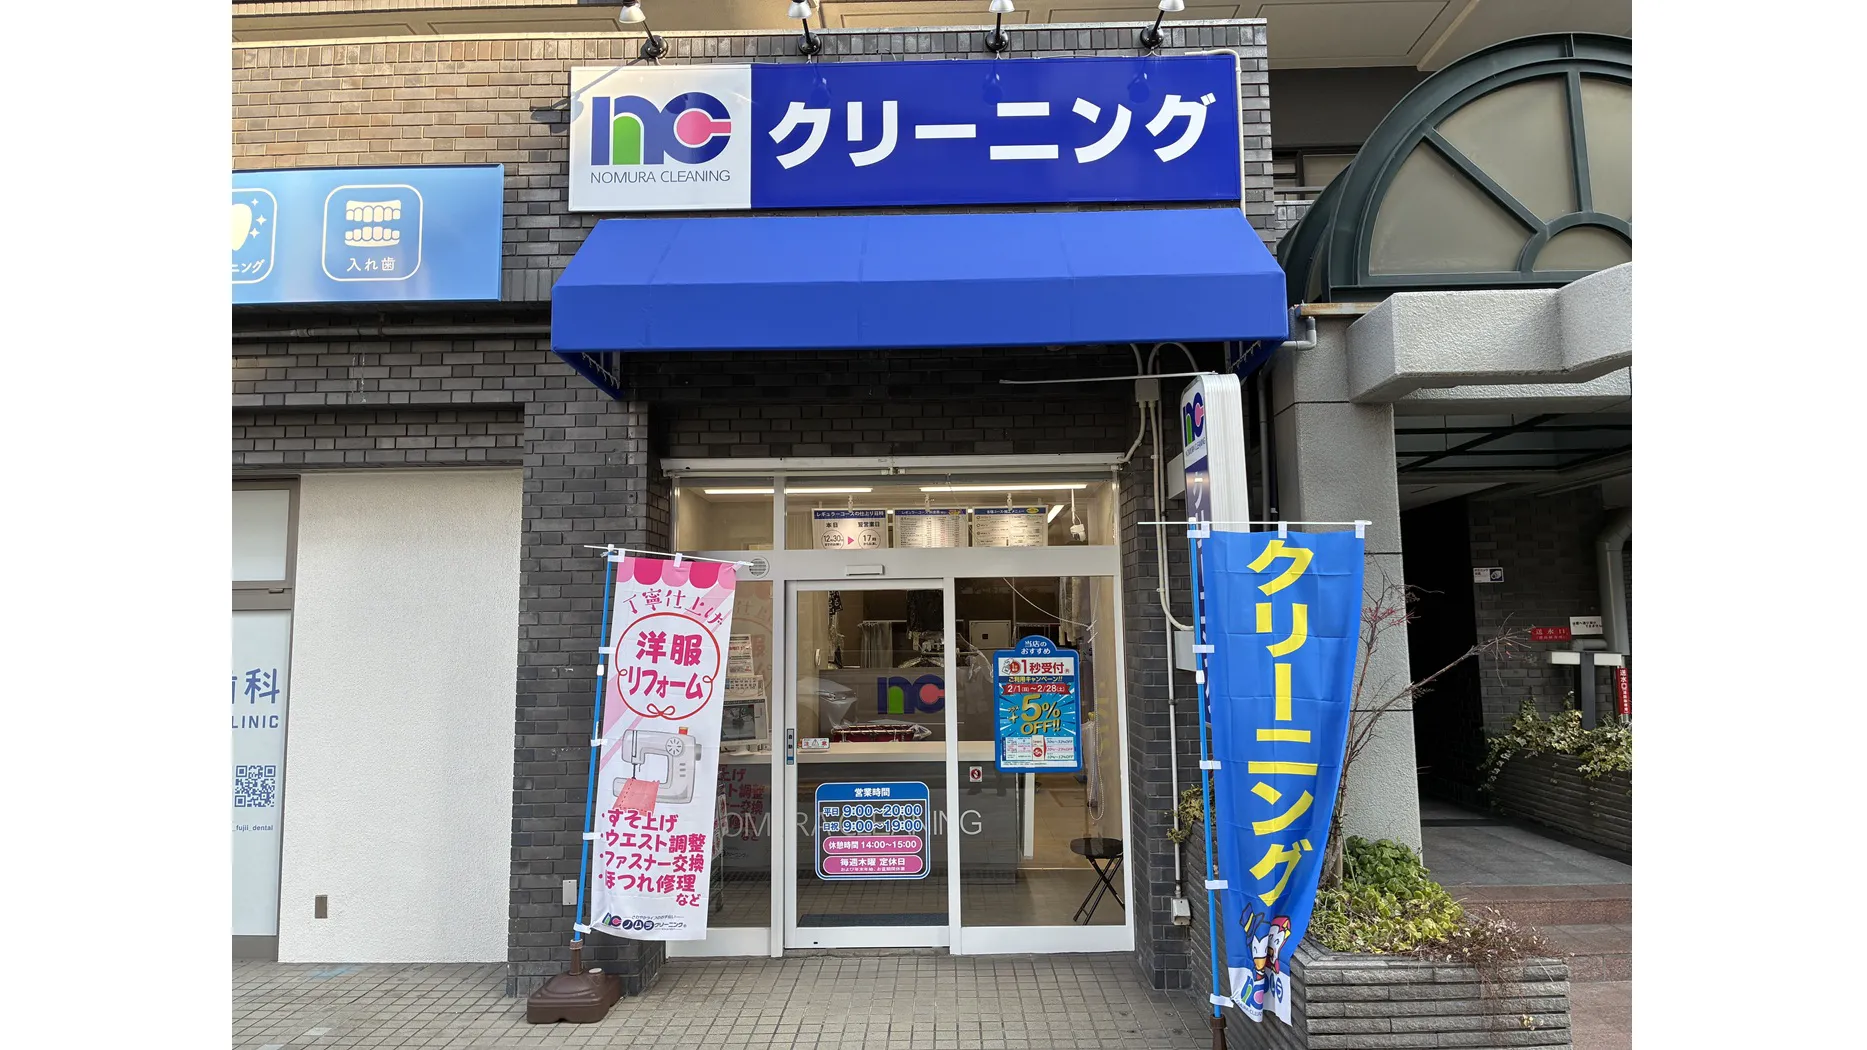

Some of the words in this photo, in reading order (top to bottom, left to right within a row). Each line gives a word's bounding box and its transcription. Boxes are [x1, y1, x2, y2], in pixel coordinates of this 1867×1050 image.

[769, 92, 1216, 169] クリーニング
[590, 171, 656, 184] NOMURA
[660, 169, 731, 183] CLEANING
[346, 256, 396, 272] 入れ歯
[623, 588, 723, 626] 丁寧仕上げ
[635, 630, 703, 667] 洋服
[1021, 659, 1065, 674] 1秒受付
[232, 668, 280, 704] 科
[628, 665, 704, 700] リフォーム
[1020, 719, 1061, 735] OFF!!
[1246, 540, 1318, 907] クリーニング
[854, 787, 891, 798] 営業時間
[823, 806, 839, 817] 平日
[823, 822, 839, 832] 日祝
[828, 841, 859, 850] 休憩時間
[840, 858, 876, 867] 毎週木曜
[879, 857, 906, 866] 定休日
[675, 893, 701, 907] など
